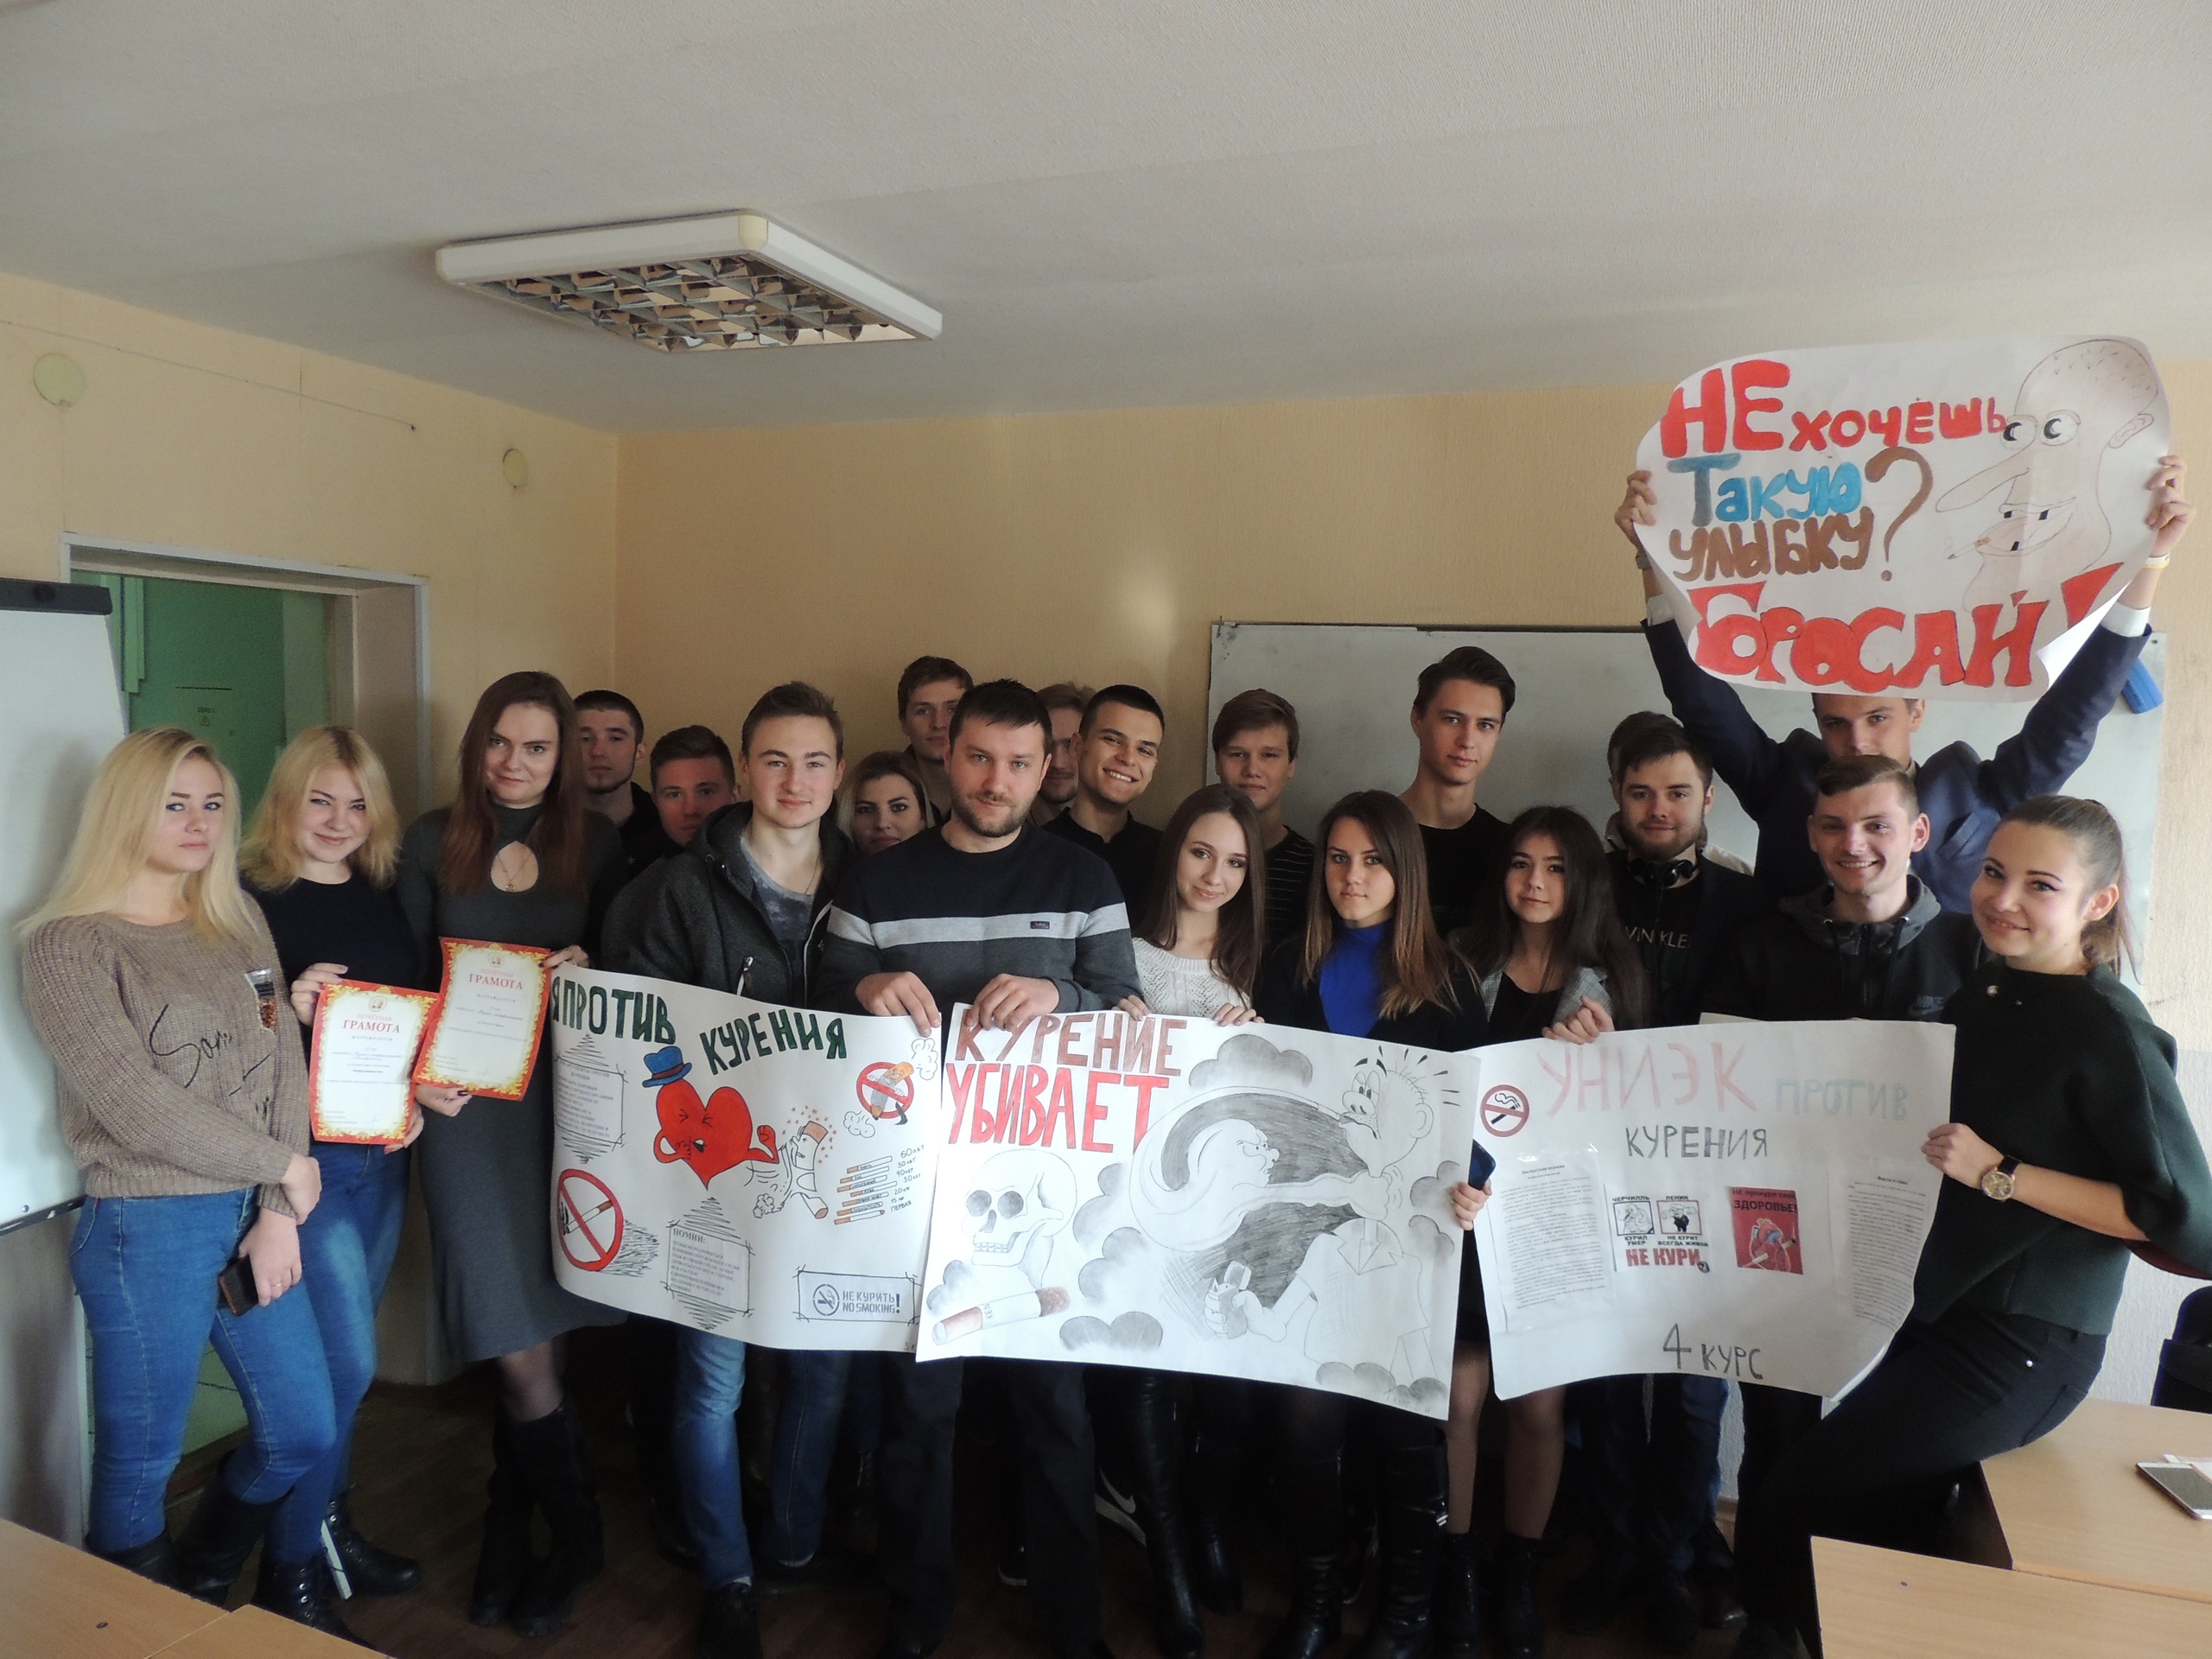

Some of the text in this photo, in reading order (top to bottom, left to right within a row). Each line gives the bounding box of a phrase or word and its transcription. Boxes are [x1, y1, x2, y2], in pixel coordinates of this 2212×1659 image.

[1660, 359, 1790, 459] НЕ
[1660, 931, 1691, 949] KLE
[469, 973, 523, 989] ГРАМОТА
[343, 1020, 400, 1033] ГРАМОТА
[552, 976, 847, 1076] Я ПРОТИВ КУРЕНИЯ
[955, 1009, 1187, 1076] КУРЕНИЕ
[1537, 1042, 1908, 1122] УНИЭК ПРОТИВ
[945, 1063, 1170, 1154] УБИВАЕТ
[1625, 1124, 1768, 1160] КУРЕНИЯ
[1734, 1200, 1798, 1213] ЗДОРОВЬЕ!
[673, 1228, 706, 1243] ПОМНИ:
[1625, 1249, 1649, 1267] НЕ
[842, 1291, 854, 1300] НЕ
[842, 1302, 854, 1313] NO
[1663, 1323, 1763, 1380] 4 КУРС
